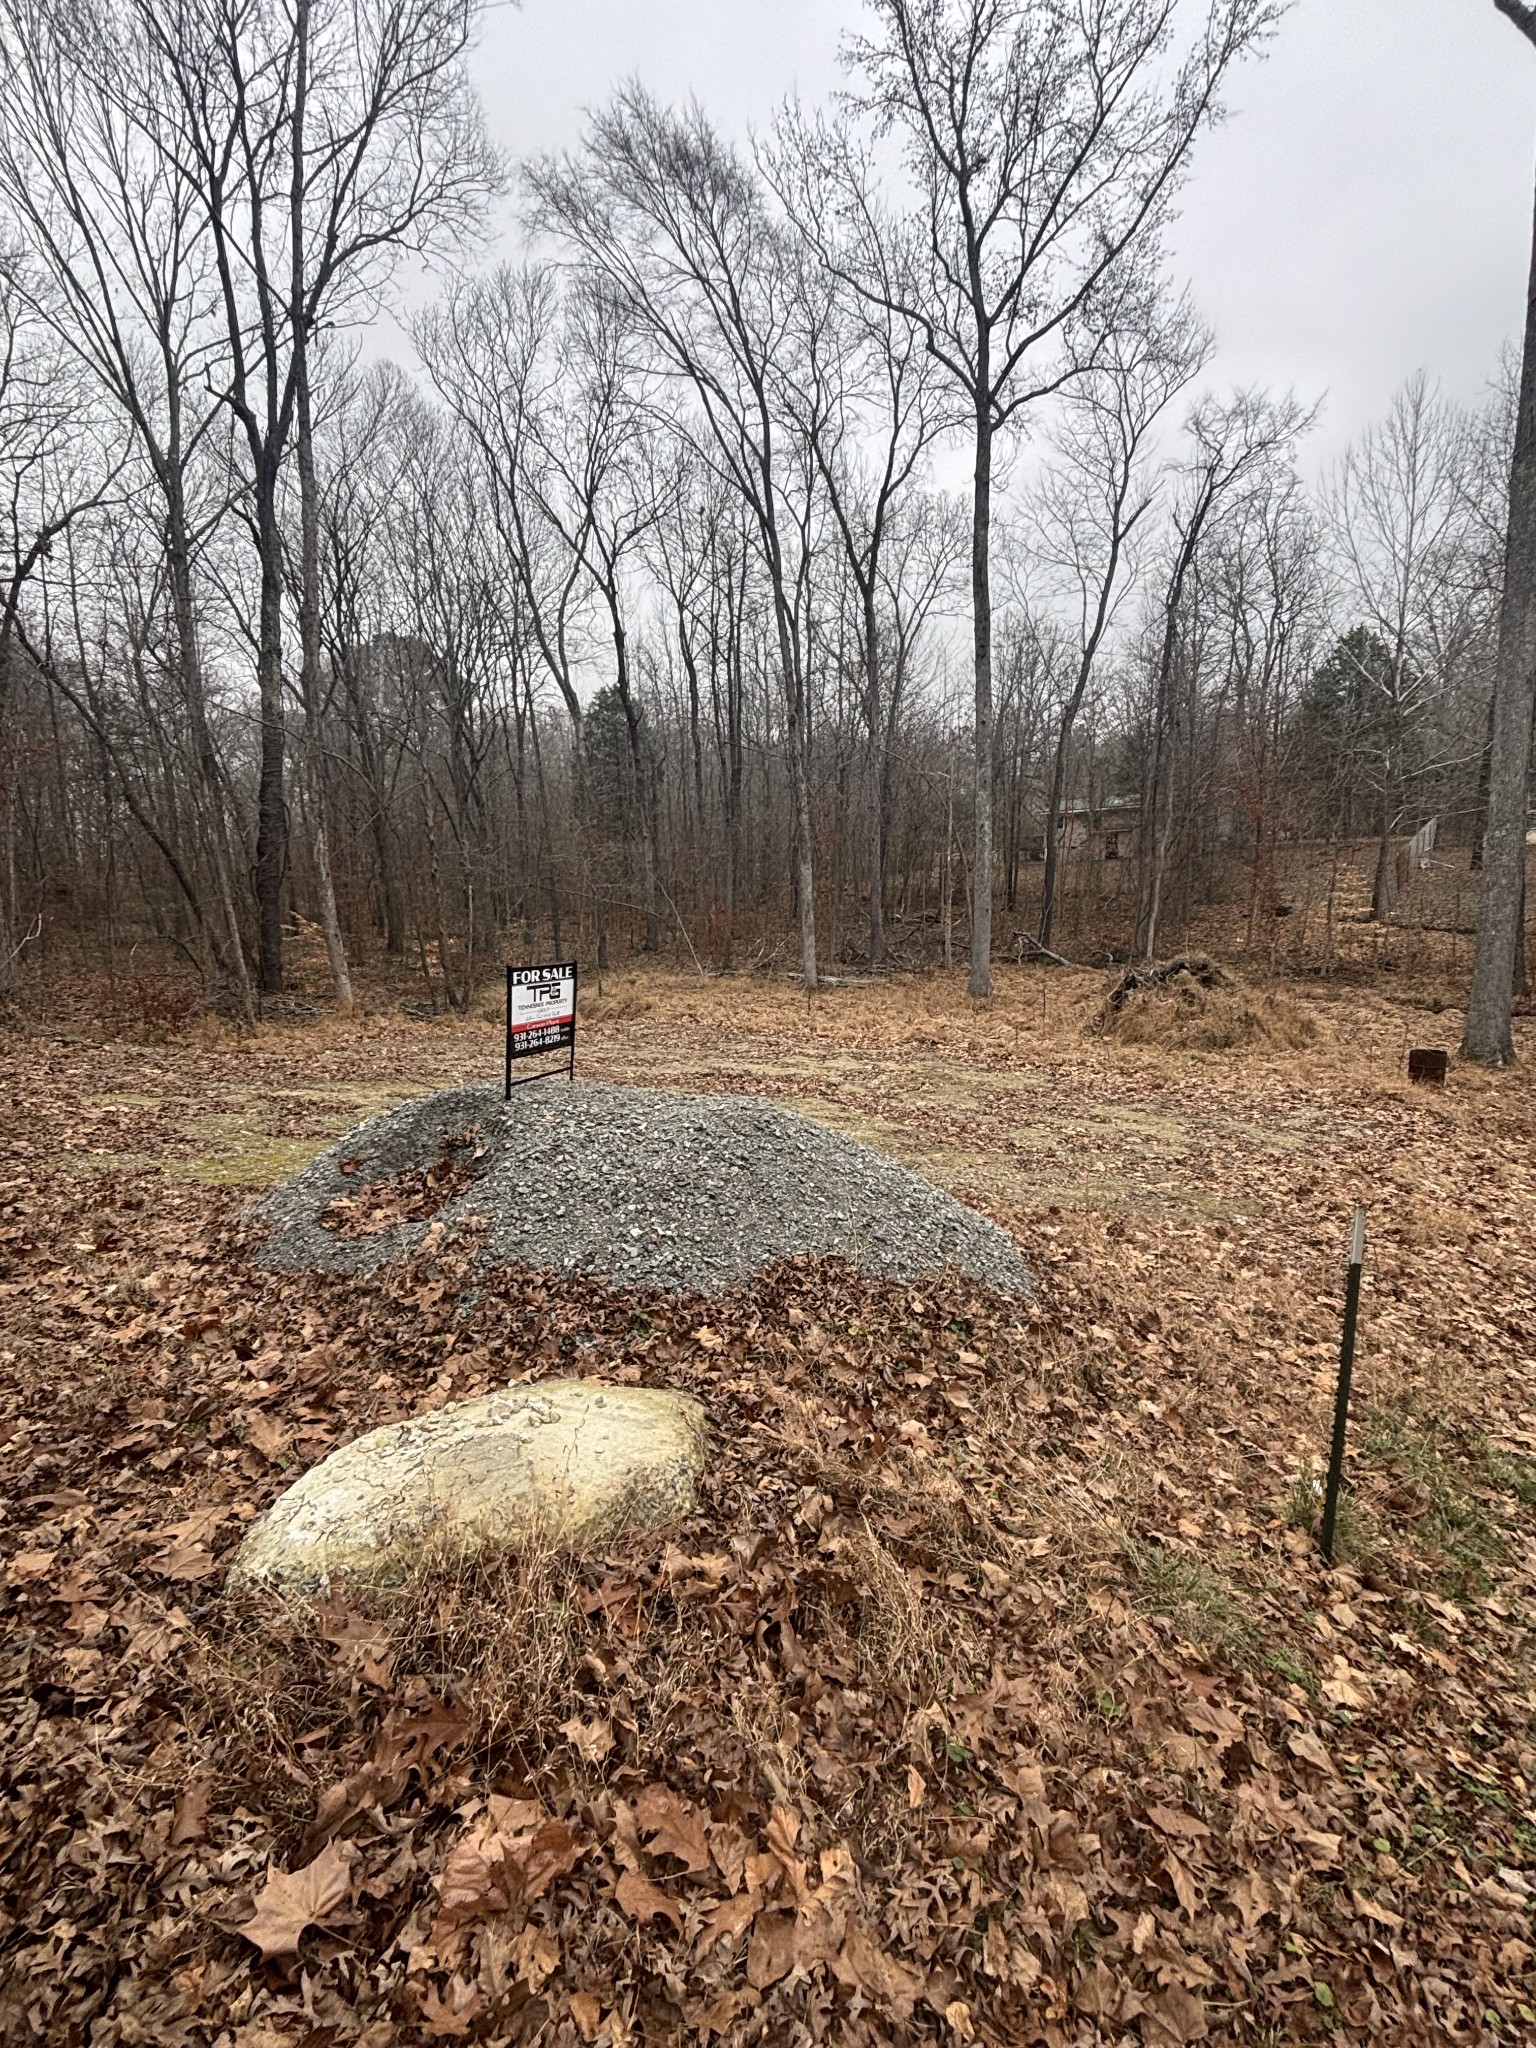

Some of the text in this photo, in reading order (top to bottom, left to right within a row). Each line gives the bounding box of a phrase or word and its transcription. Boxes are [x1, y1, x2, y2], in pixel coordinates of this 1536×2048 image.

[512, 966, 573, 985] FOR SALE
[518, 998, 568, 1011] TENNESSEE PROPERTY
[514, 1034, 561, 1051] 931-264-8219
